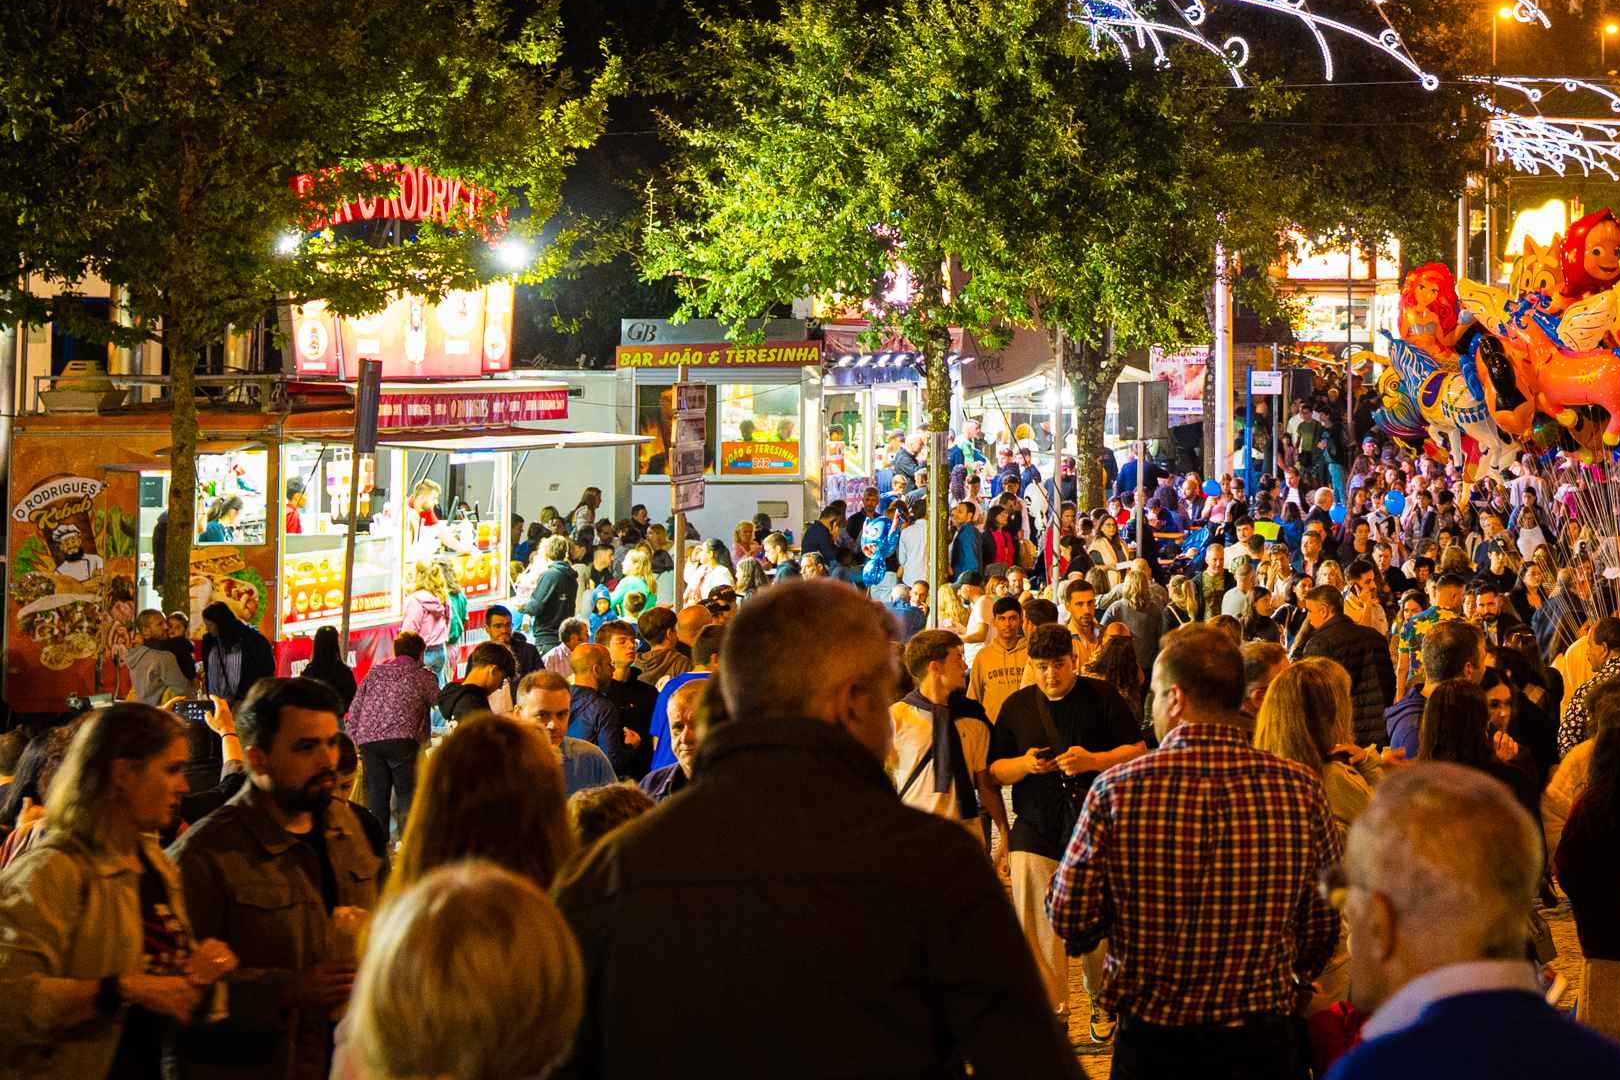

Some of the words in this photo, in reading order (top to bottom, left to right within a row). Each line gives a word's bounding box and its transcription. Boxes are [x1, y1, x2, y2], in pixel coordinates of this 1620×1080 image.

[627, 321, 657, 343] GB
[620, 352, 654, 367] BAR
[657, 348, 704, 365] JOÃO
[708, 351, 721, 364] &
[725, 347, 820, 364] TERESINHA
[15, 508, 26, 520] O
[25, 482, 98, 511] RODRIGUES
